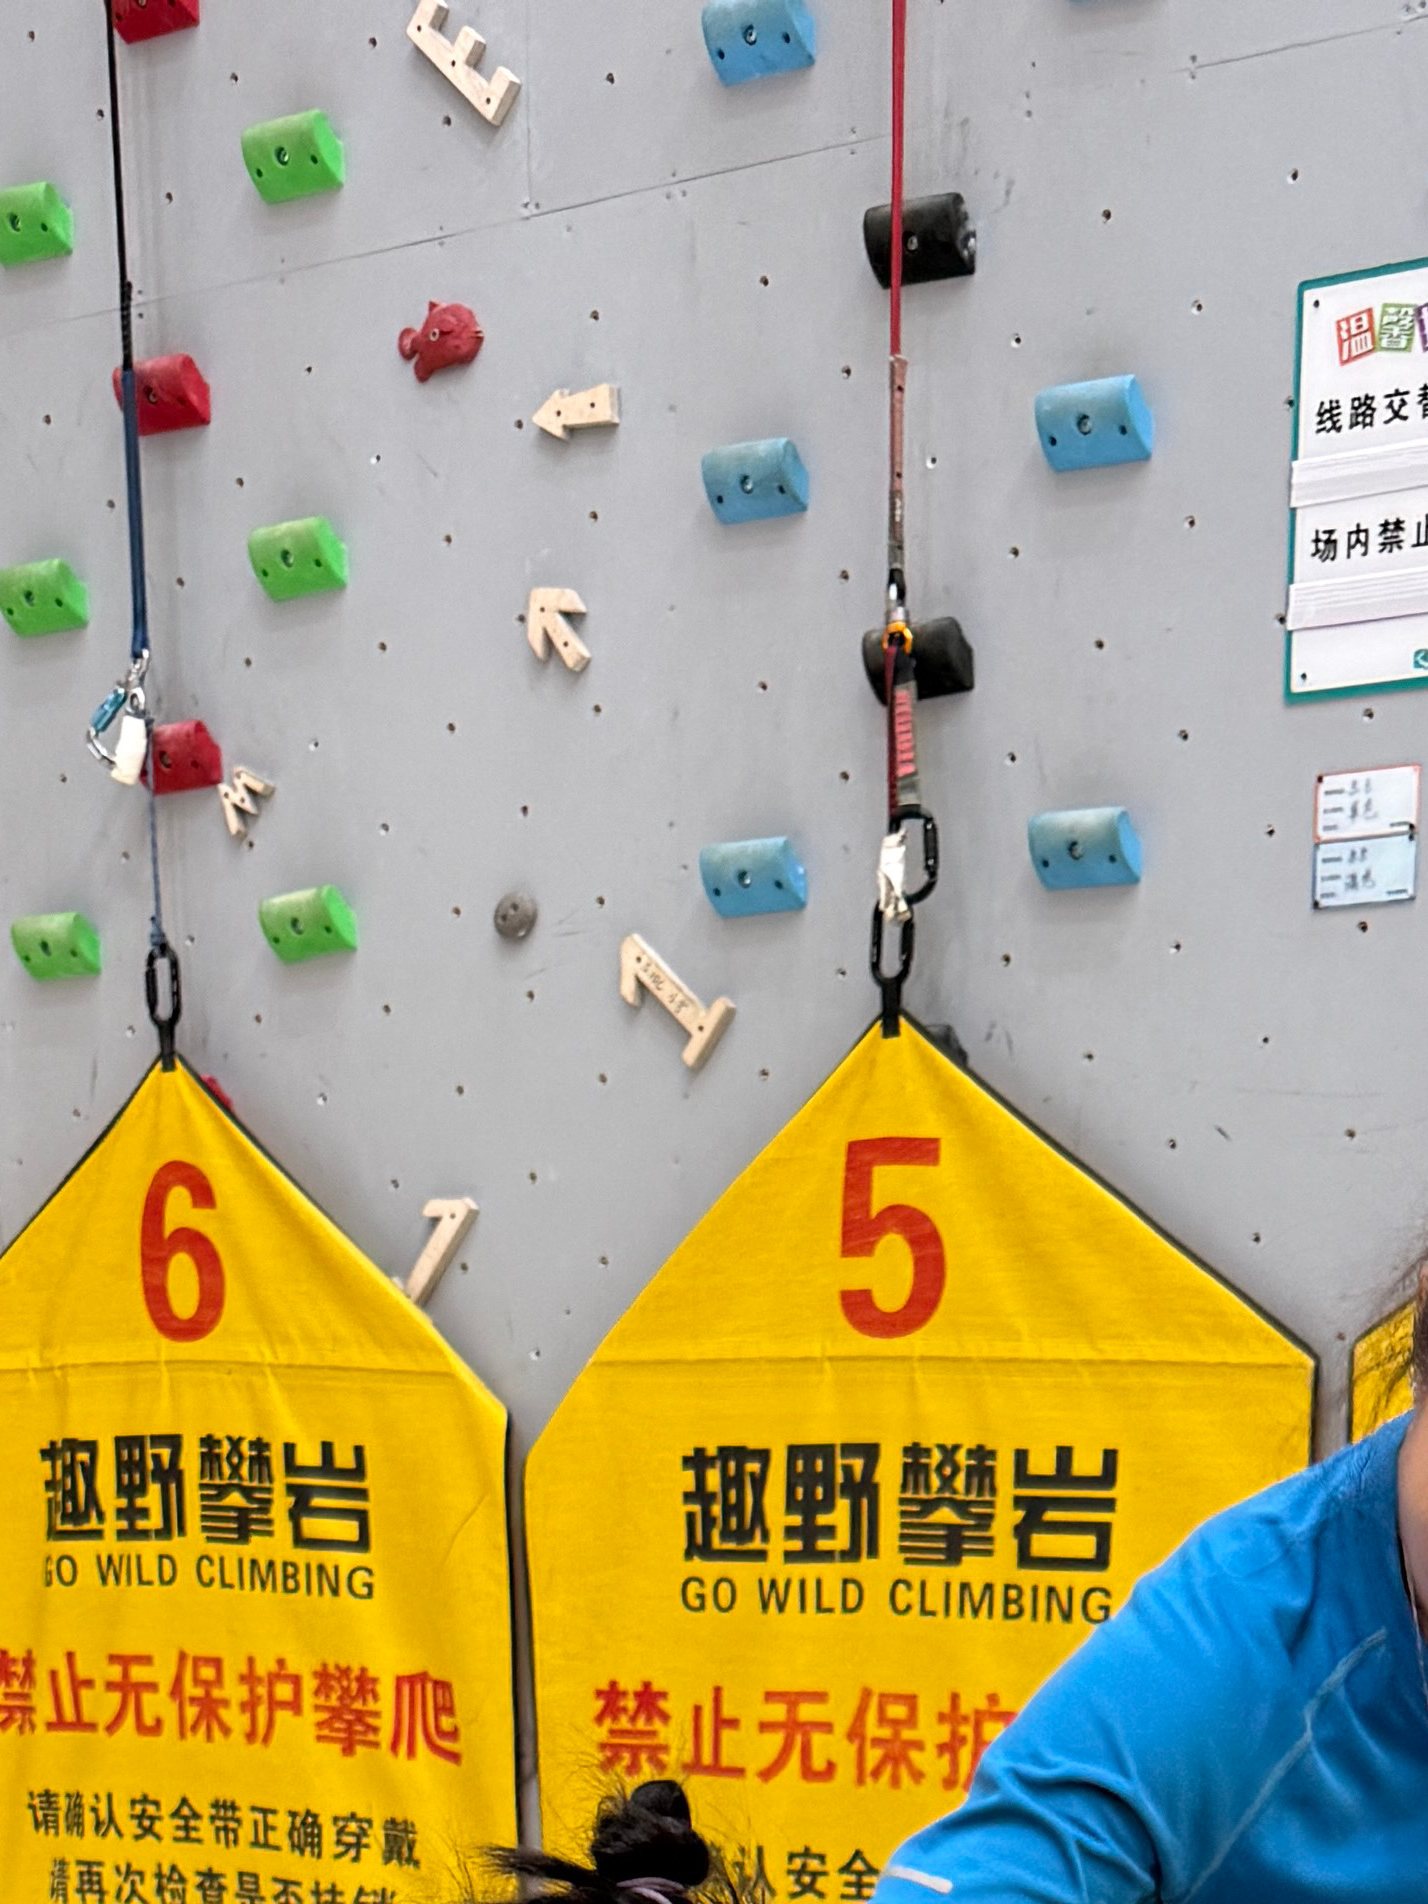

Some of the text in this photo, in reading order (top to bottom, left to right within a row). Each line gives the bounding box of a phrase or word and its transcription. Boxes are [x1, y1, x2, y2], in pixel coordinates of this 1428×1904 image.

[141, 1161, 222, 1340] 6
[841, 1137, 944, 1336] 5
[40, 1434, 370, 1552] 趣野攀岩
[682, 1442, 1117, 1571] 趣野攀岩
[43, 1550, 372, 1598] GO WILD CLIMBING
[682, 1578, 1110, 1624] GO WILD CLIMBING
[25, 1788, 424, 1870] 请确认安全带正确穿戴
